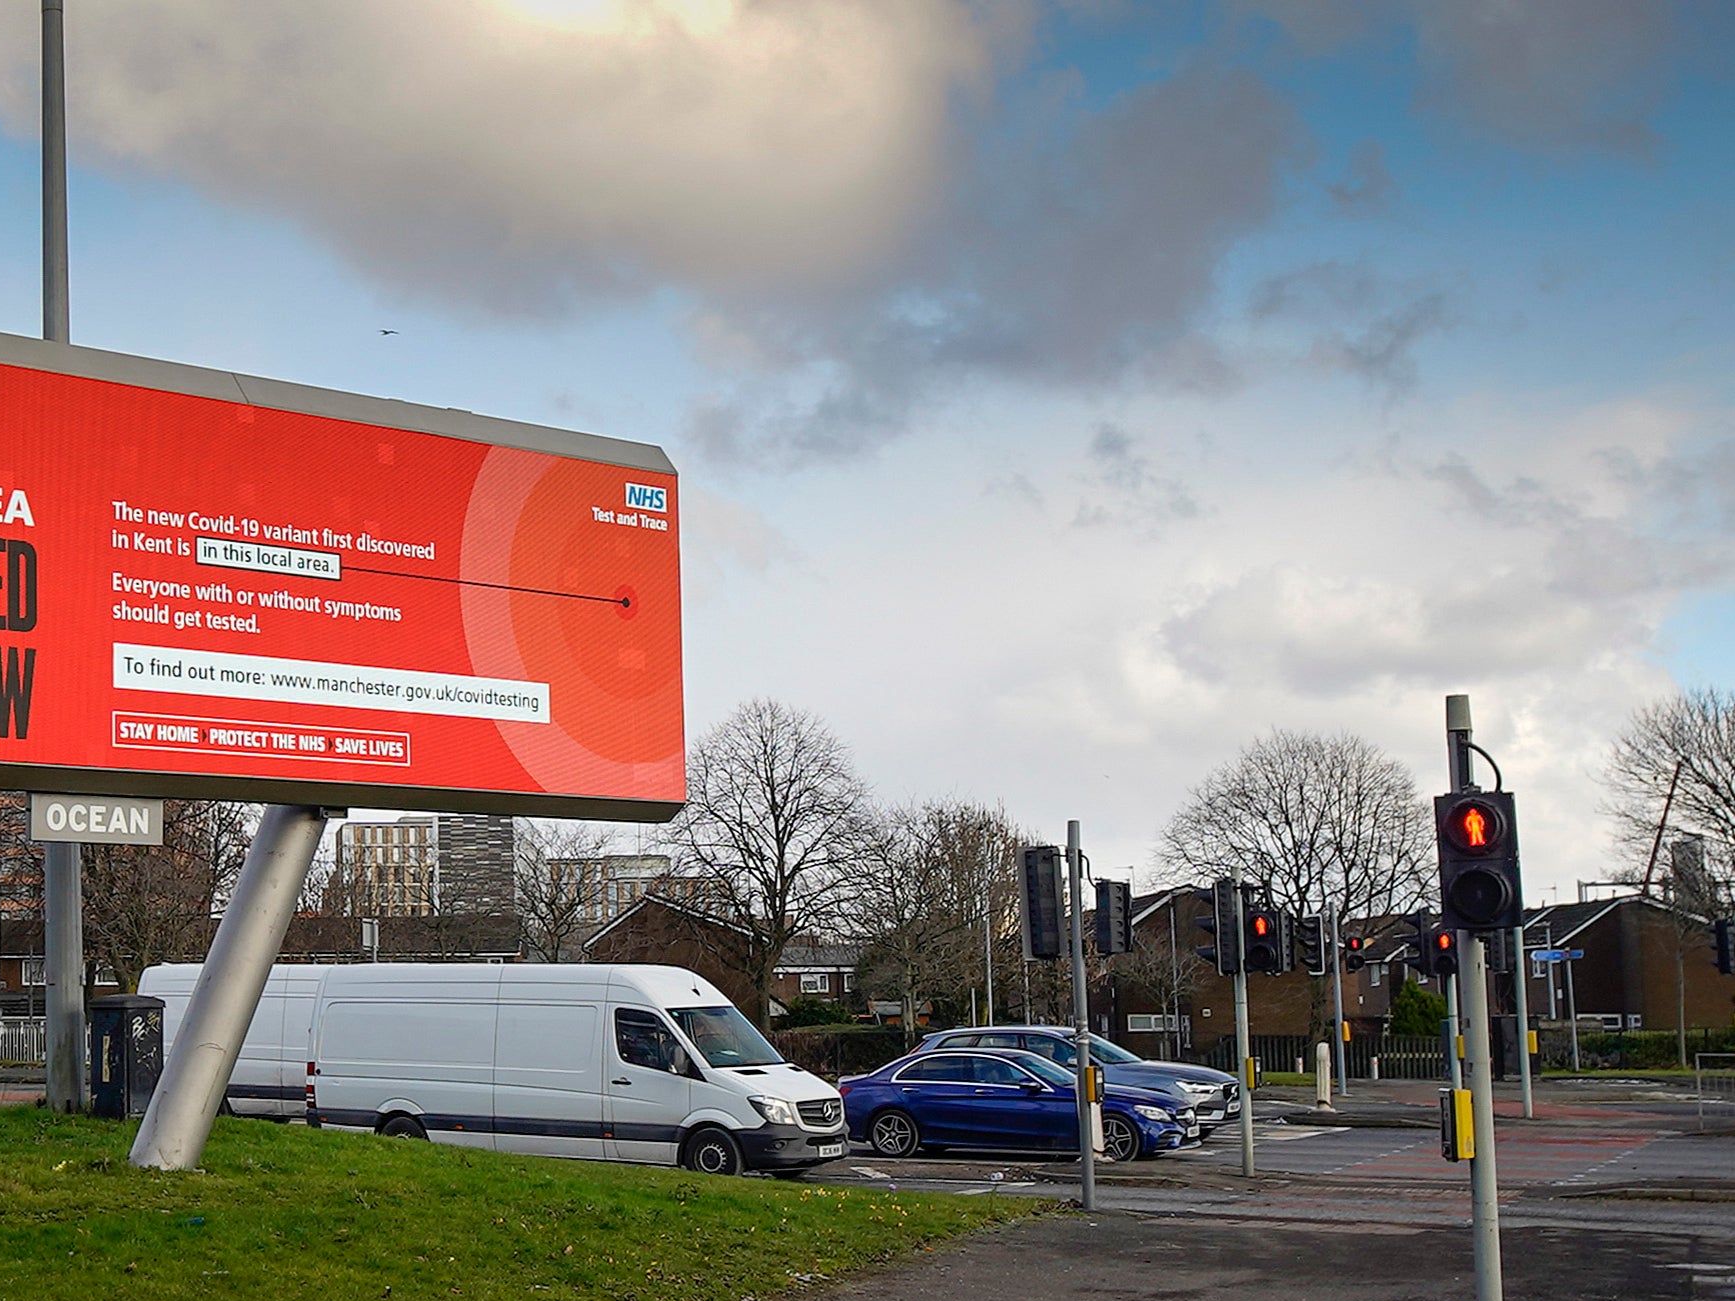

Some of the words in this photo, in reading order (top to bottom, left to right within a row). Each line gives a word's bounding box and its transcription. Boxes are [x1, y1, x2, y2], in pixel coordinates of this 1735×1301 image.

[628, 486, 664, 509] NHS
[112, 501, 143, 522] The
[148, 510, 184, 527] new
[188, 512, 259, 537] Covid-19
[263, 525, 318, 545] variant
[322, 528, 352, 549] first
[356, 533, 435, 560] discovered
[592, 507, 615, 523] Test
[617, 512, 637, 526] and
[639, 514, 667, 531] Trace
[112, 529, 129, 548] in
[134, 532, 172, 554] Kent
[177, 538, 191, 555] is
[203, 542, 217, 557] in
[223, 544, 252, 562] this
[257, 548, 291, 567] local
[297, 556, 334, 573] area.
[112, 572, 191, 598] Everyone
[195, 584, 232, 603] with
[236, 590, 254, 605] or
[258, 591, 321, 612] without
[324, 600, 402, 621] symptoms
[112, 601, 169, 624] should
[174, 611, 202, 629] get
[206, 612, 261, 633] tested.
[124, 656, 144, 675] To
[150, 658, 182, 679] find
[188, 664, 215, 681] out
[220, 670, 265, 685] more:
[271, 672, 540, 712] www.manchester.gov.uk/covidtesting
[119, 721, 154, 741] STAY
[157, 724, 199, 744] HOME
[209, 728, 267, 749] PROTECT
[271, 734, 296, 751] THE
[299, 736, 326, 752] NHS
[335, 738, 367, 756] SAVE
[369, 740, 404, 758] LIVES
[46, 803, 150, 835] OCEAN
